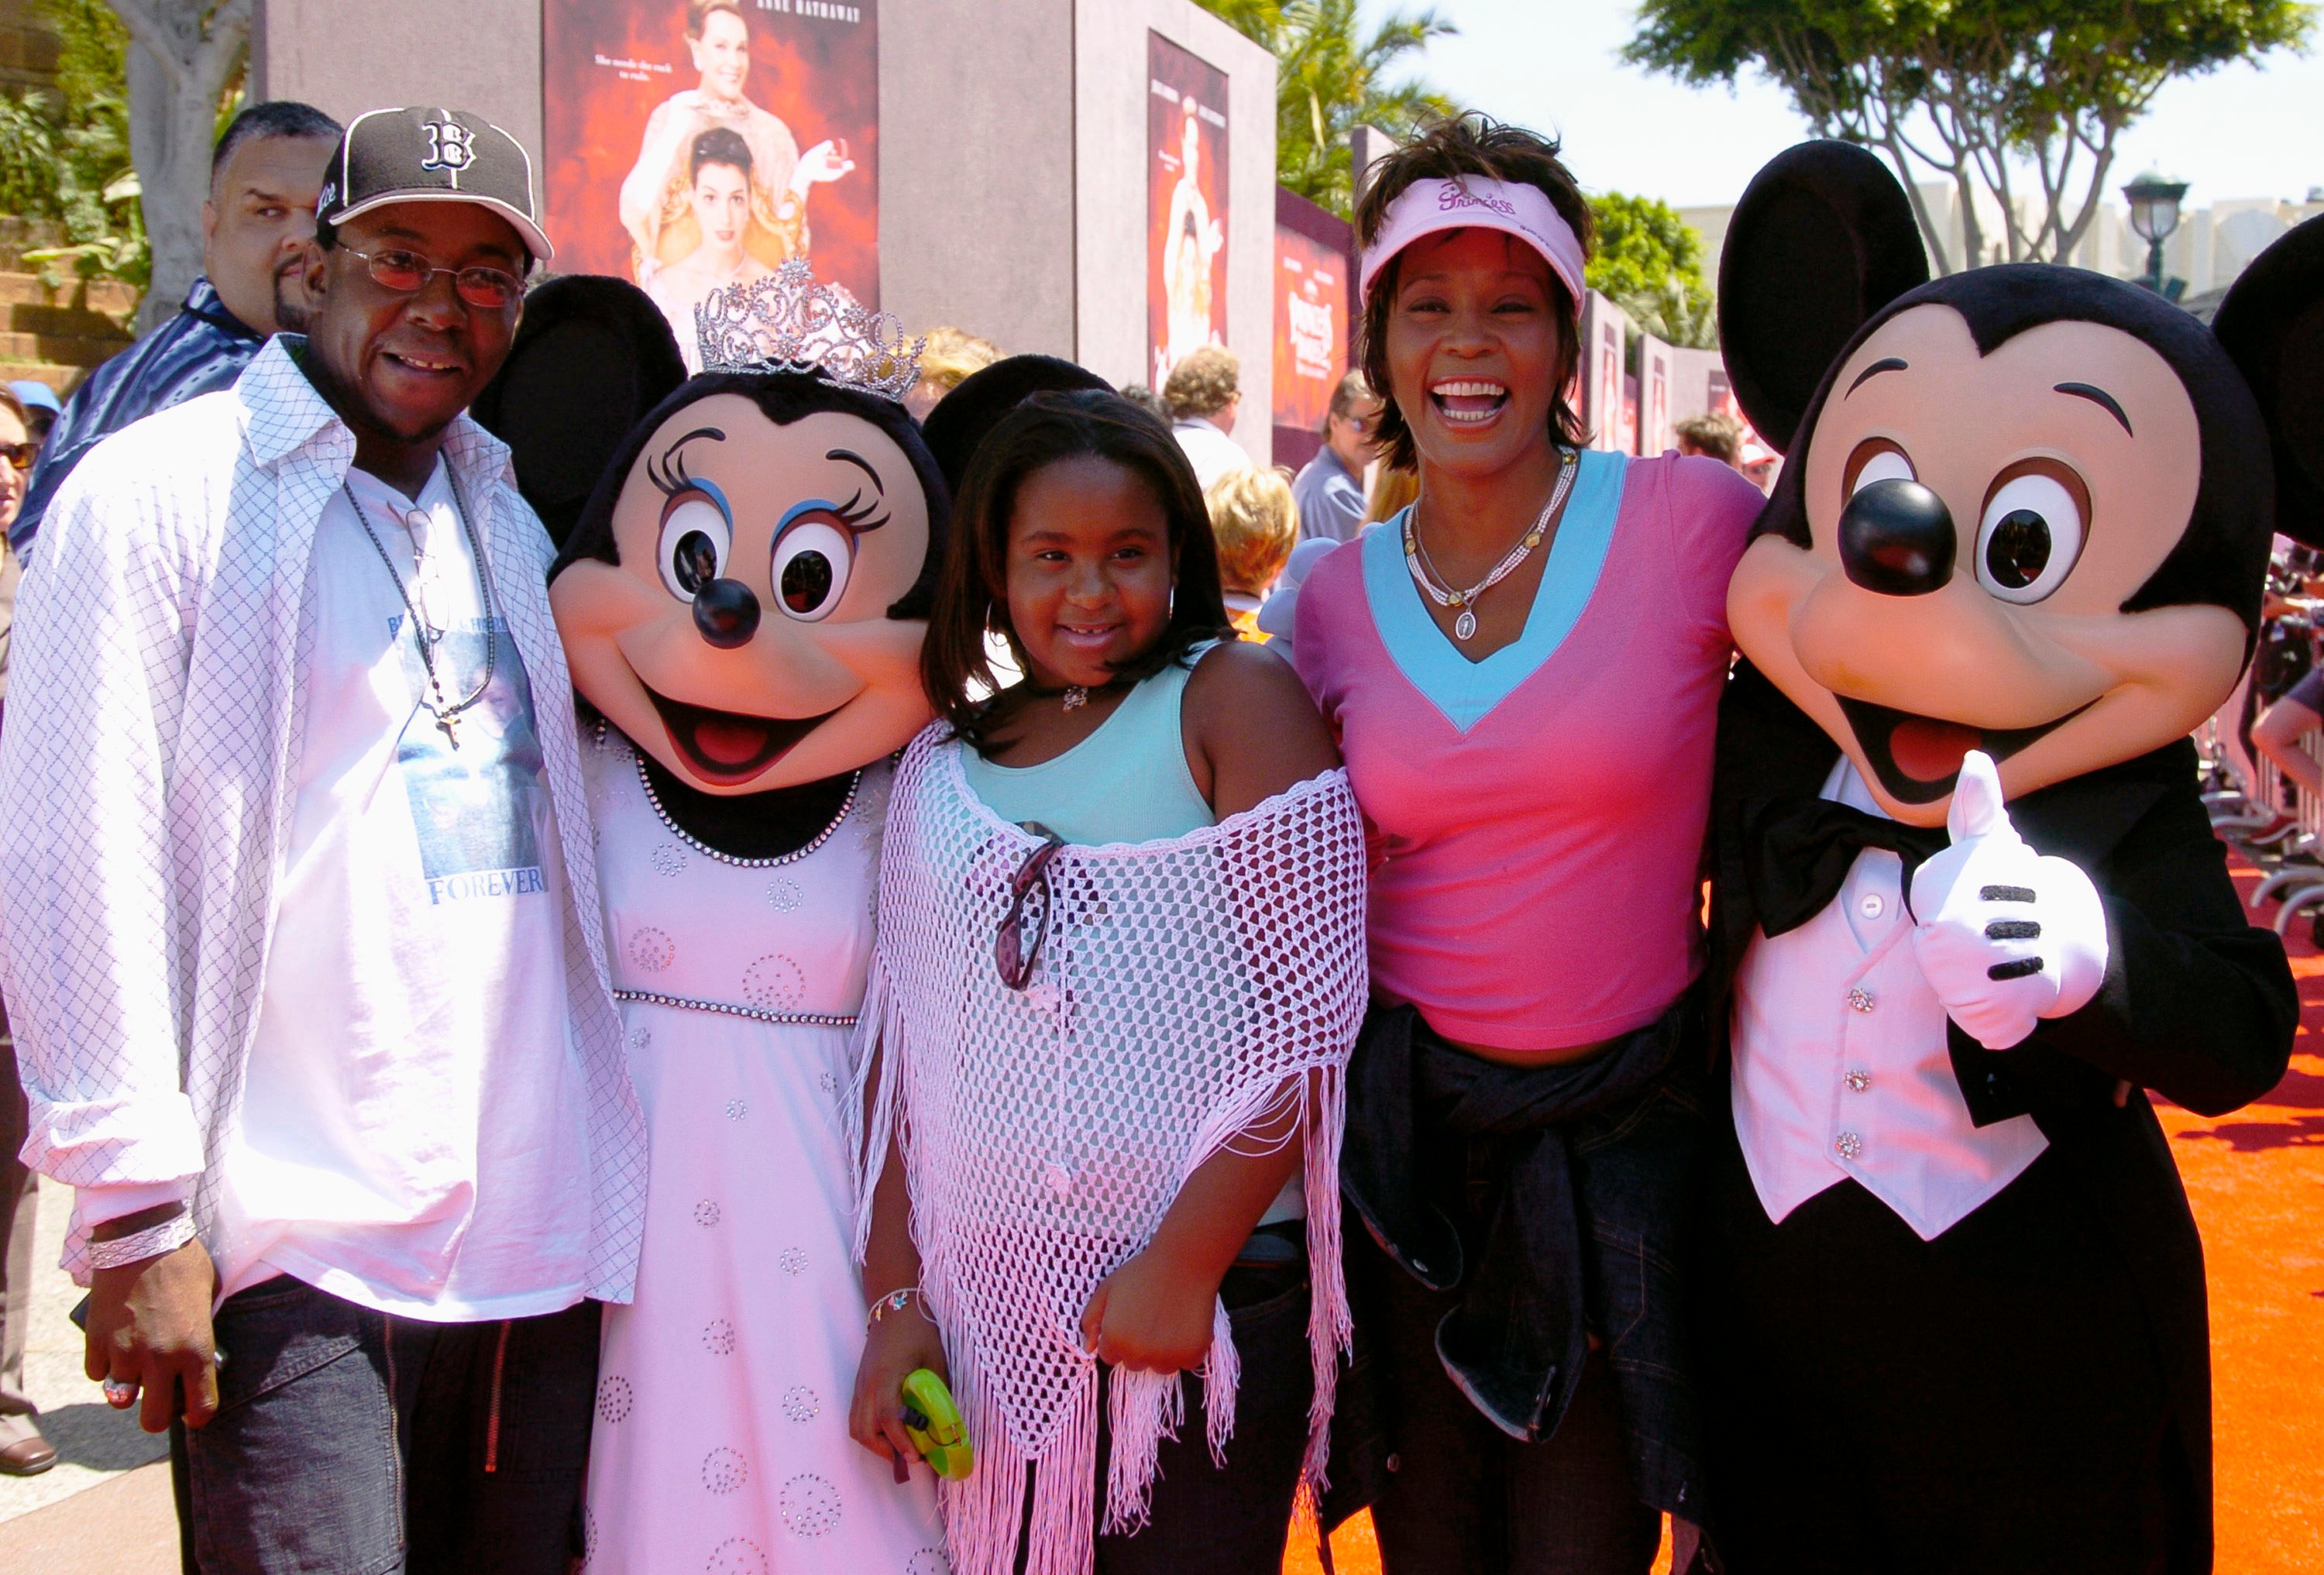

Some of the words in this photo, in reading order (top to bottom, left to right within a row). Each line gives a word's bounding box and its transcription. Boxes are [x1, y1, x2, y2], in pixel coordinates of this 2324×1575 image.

[612, 58, 638, 69] needs
[638, 60, 653, 70] the
[421, 121, 477, 171] B
[1438, 181, 1515, 215] Princess
[428, 868, 543, 905] FOREVER
